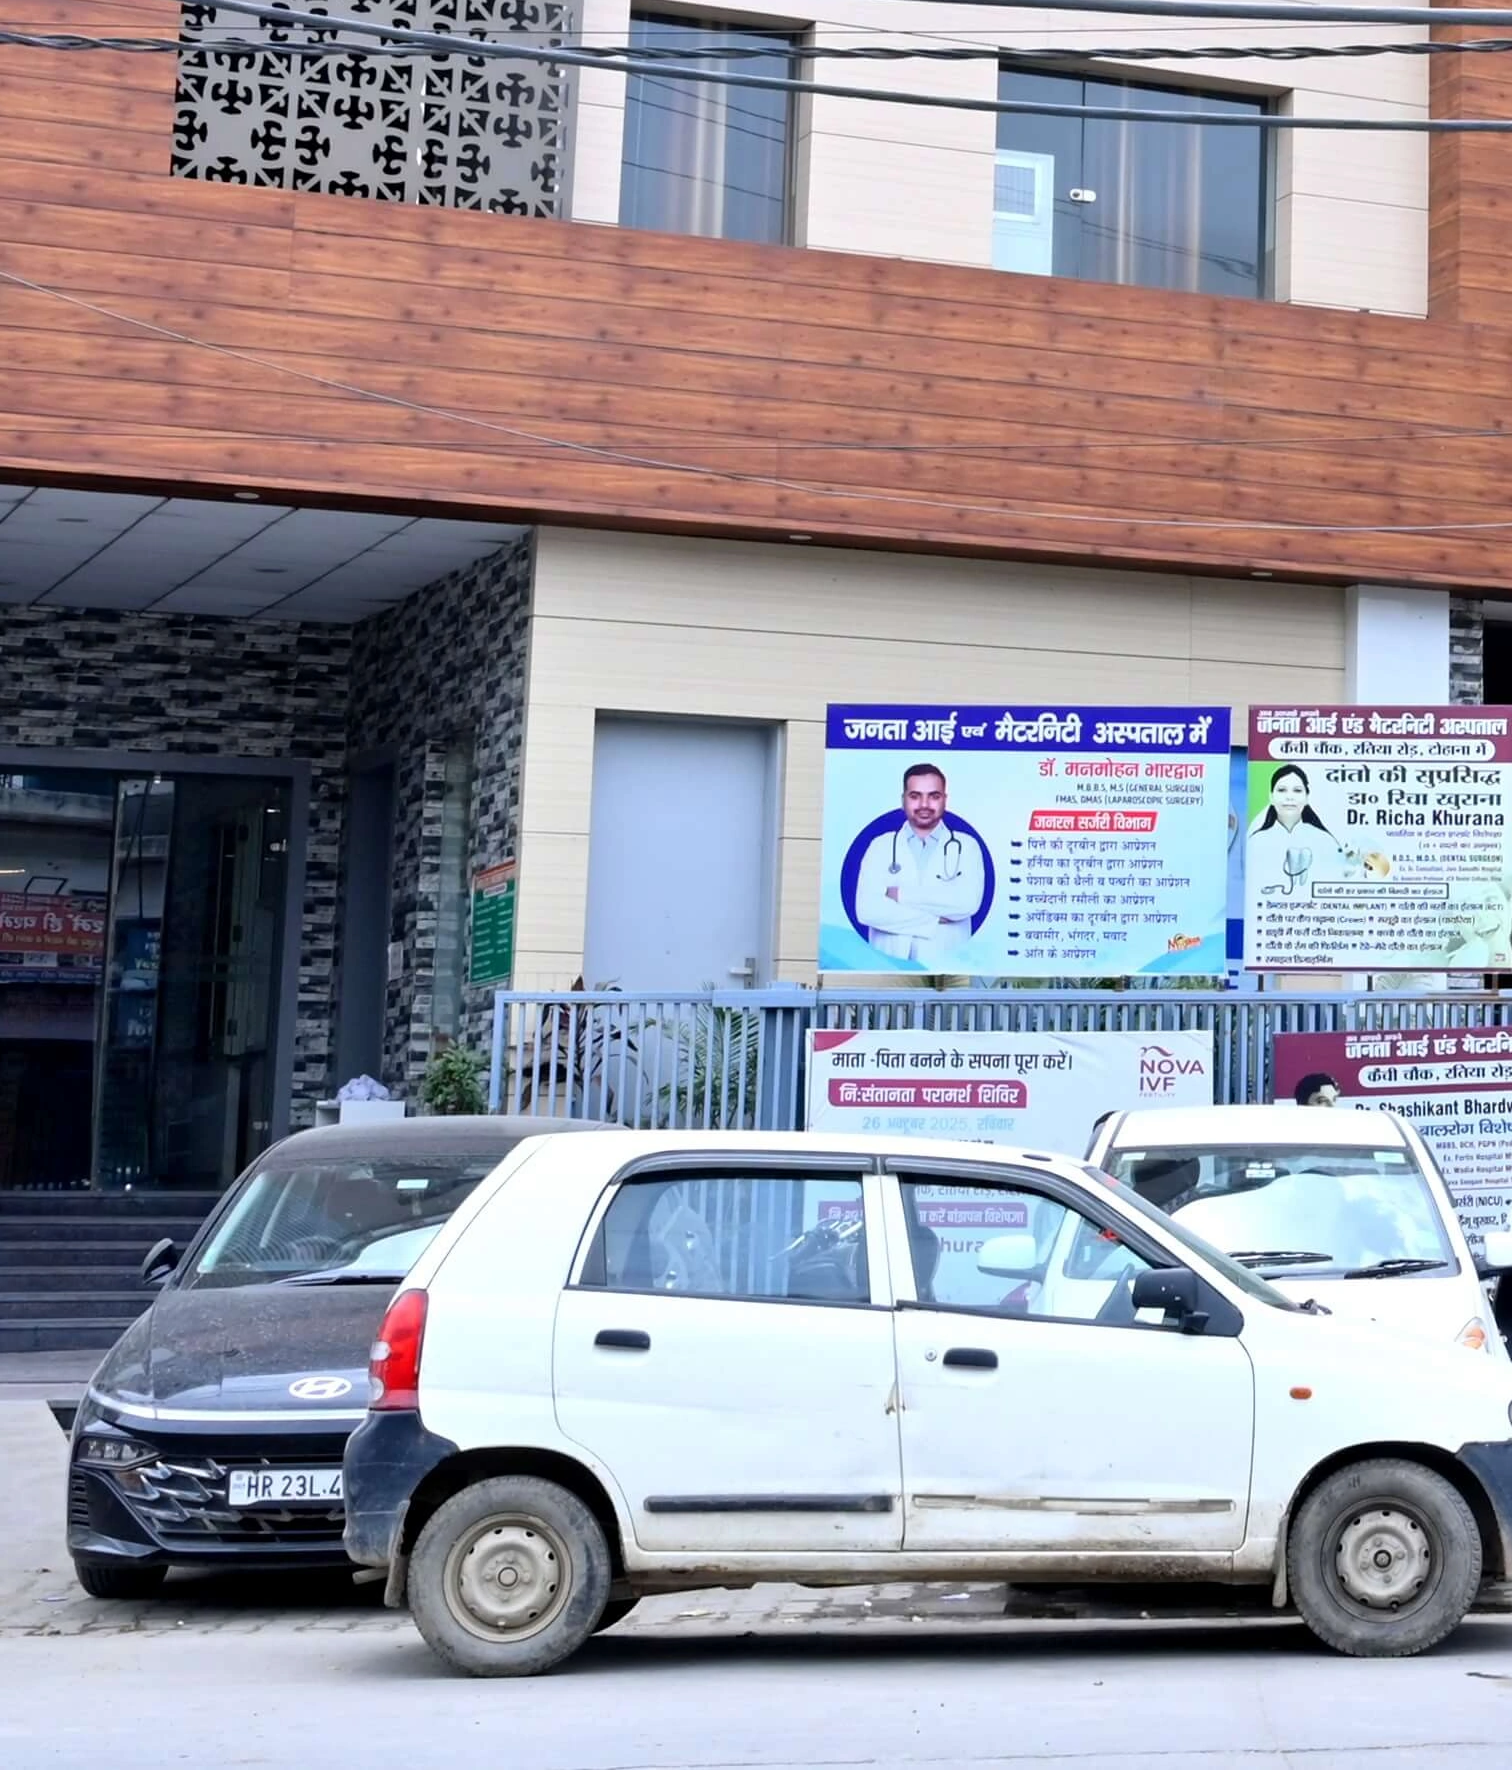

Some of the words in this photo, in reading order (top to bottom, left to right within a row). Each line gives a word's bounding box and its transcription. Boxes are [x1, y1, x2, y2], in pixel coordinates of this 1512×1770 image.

[844, 718, 908, 741] जनता
[912, 712, 958, 746] आई
[961, 723, 987, 738] एवं
[995, 712, 1082, 744] मैटरनिटी
[1093, 723, 1185, 747] अस्पताल
[1188, 715, 1212, 745] में
[1039, 756, 1059, 778] डॉ.
[1064, 759, 1139, 779] मनमोहन
[1145, 760, 1204, 781] भारद्वाज
[1325, 764, 1371, 784] दांतो
[1380, 764, 1407, 783] की
[1416, 764, 1502, 789] सुप्रसिद्ध
[1347, 809, 1369, 826] Dr.
[1376, 808, 1425, 827] Richa
[1432, 808, 1505, 827] Khurana
[1140, 1058, 1205, 1076] NOVA
[839, 1083, 917, 1104] निःसंतानता
[922, 1083, 972, 1104] परामर्श
[978, 1083, 1019, 1104] शिविर
[1139, 1076, 1178, 1092] IVF
[246, 1475, 274, 1499] HR
